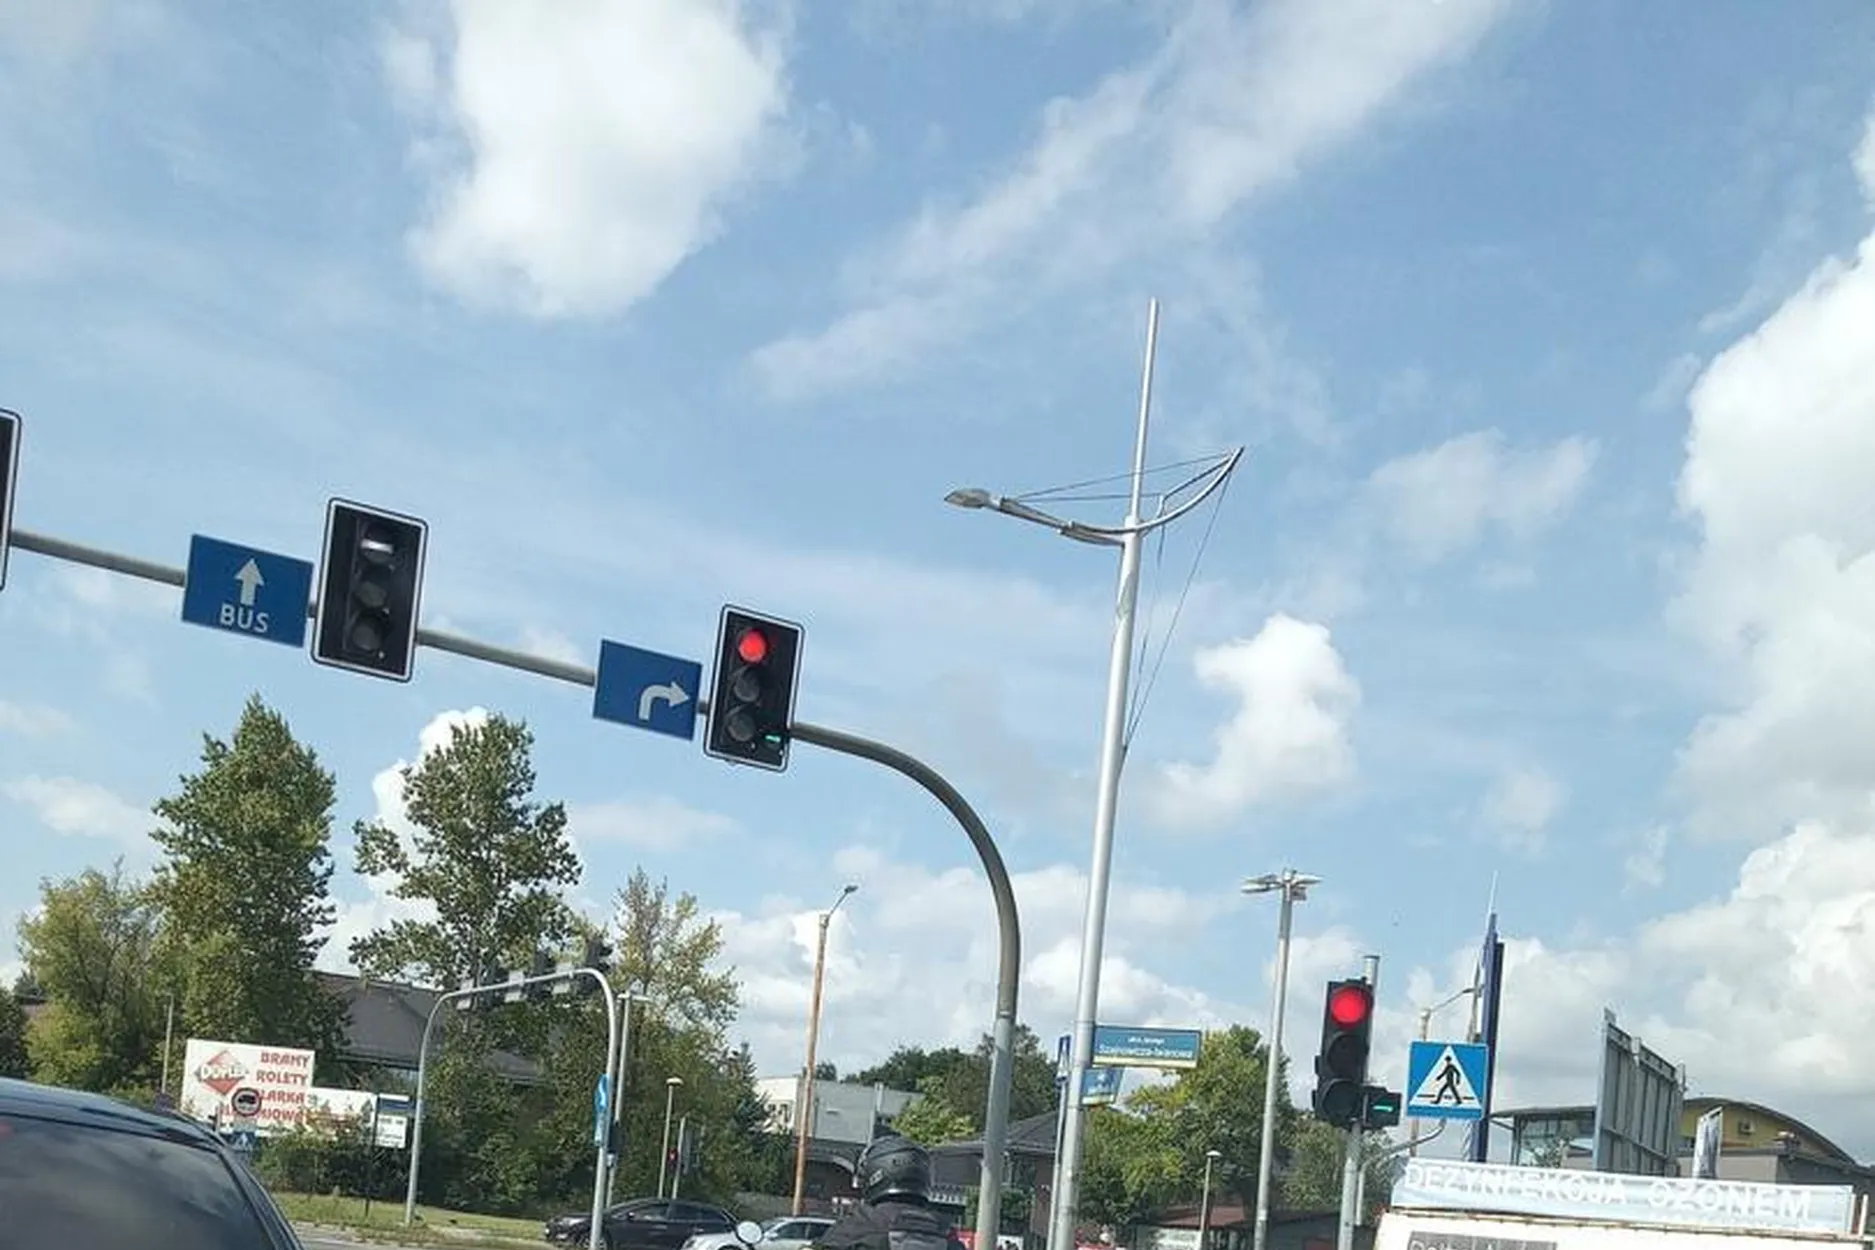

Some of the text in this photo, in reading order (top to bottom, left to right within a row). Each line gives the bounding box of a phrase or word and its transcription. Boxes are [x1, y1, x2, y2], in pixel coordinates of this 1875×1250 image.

[221, 602, 269, 633] BUS
[260, 1051, 311, 1068] BRAMY
[255, 1068, 309, 1087] ROLETY
[1648, 1181, 1812, 1220] OZONEM
